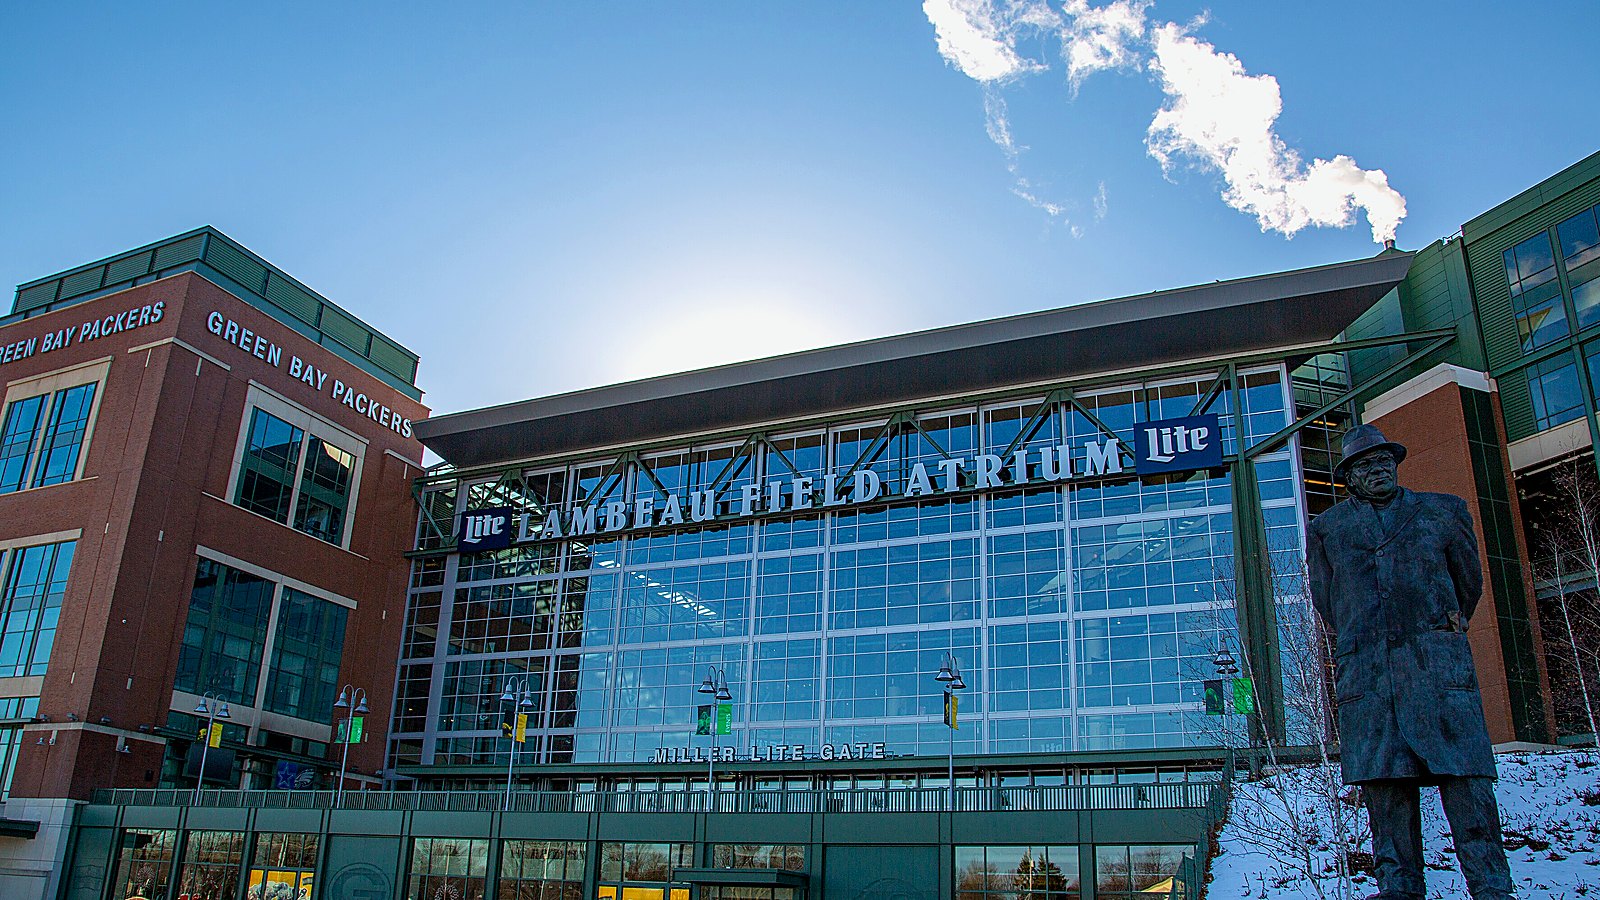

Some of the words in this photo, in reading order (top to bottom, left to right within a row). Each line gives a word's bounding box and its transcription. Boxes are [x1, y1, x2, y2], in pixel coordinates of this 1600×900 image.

[40, 325, 77, 353] BAY
[78, 301, 166, 342] PACKERS
[206, 310, 282, 368] GREEN
[288, 354, 328, 391] BAY
[331, 378, 413, 438] PACKERS
[1144, 425, 1209, 464] Lite
[517, 489, 715, 542] LAMBEAU
[740, 469, 882, 516] FIELD
[903, 437, 1124, 497] ATRIUM
[464, 512, 506, 544] Lite
[653, 747, 737, 763] MILLER
[751, 745, 806, 761] LITE
[821, 743, 886, 761] GATE
